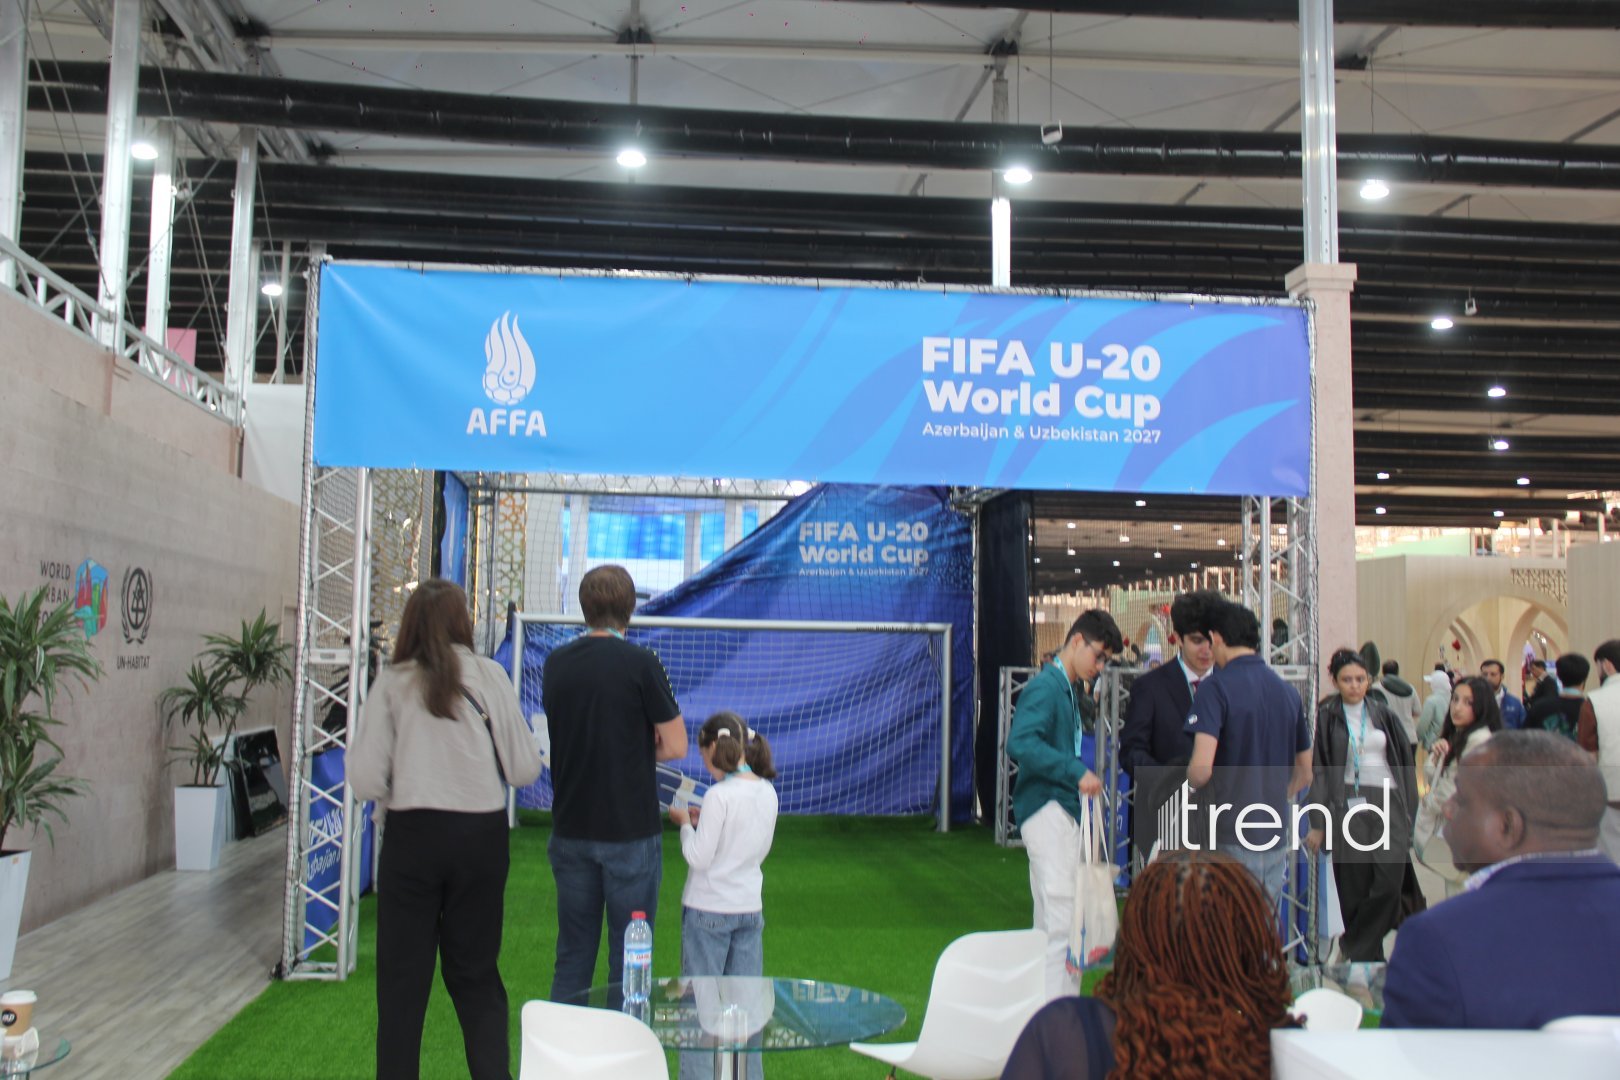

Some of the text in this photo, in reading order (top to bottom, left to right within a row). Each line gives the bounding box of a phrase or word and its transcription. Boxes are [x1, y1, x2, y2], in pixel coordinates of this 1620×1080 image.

[922, 336, 1161, 382] FIFA U-20
[923, 379, 1161, 427] World Cup
[466, 407, 547, 437] AFFA
[922, 422, 1161, 444] Azerbaijan & Uzbekistan 2027
[799, 521, 929, 542] FIFA U-20
[799, 544, 929, 566] World Cup
[40, 560, 71, 580] WORLD
[45, 586, 70, 603] RBAN
[117, 656, 150, 670] UN-HABITAT
